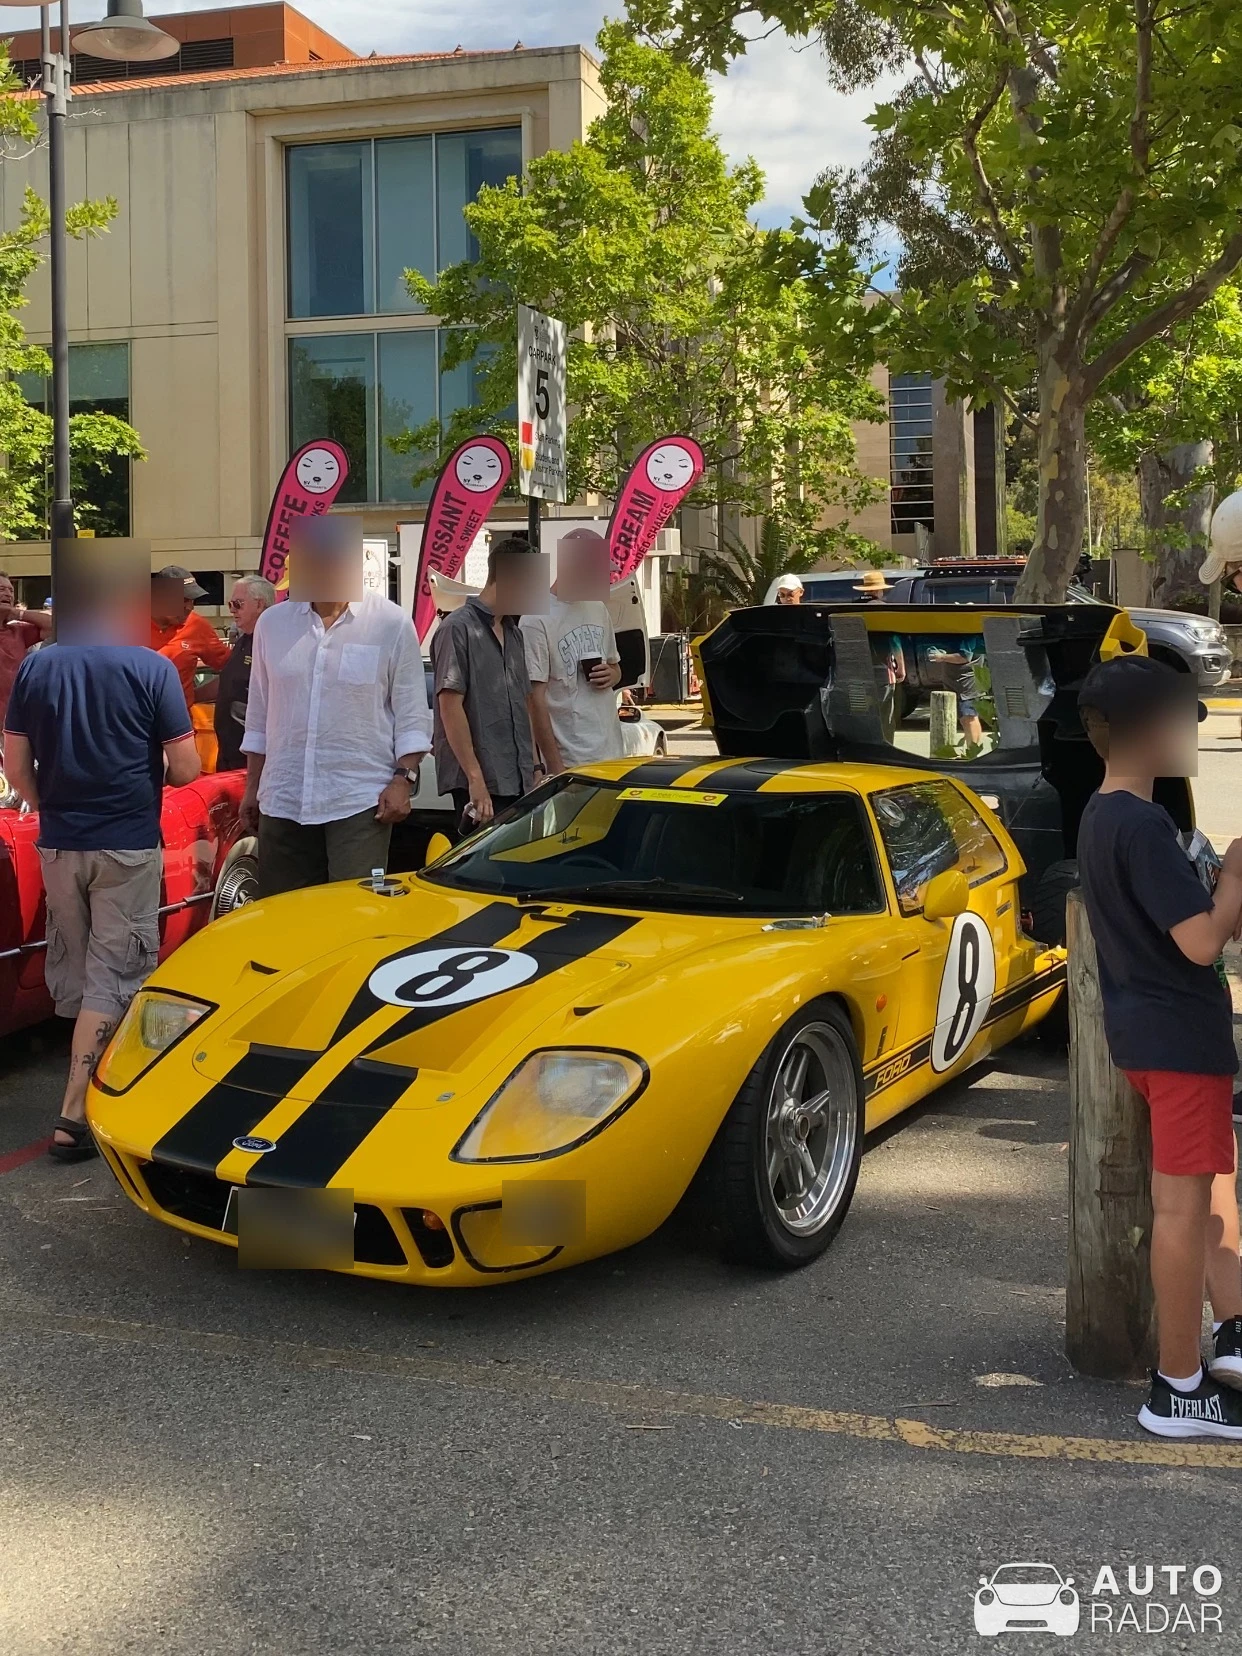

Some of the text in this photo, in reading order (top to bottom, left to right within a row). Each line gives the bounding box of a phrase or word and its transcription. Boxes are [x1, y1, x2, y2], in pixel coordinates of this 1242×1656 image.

[528, 345, 557, 366] CARPARK
[535, 368, 550, 420] 5
[545, 434, 561, 449] Parking
[548, 465, 564, 480] Parking
[460, 509, 483, 542] SWEET
[611, 488, 657, 570] CREAM
[629, 540, 651, 571] OADED
[648, 502, 674, 540] SHAKES
[421, 490, 467, 597] COISSANT
[458, 542, 468, 553] &
[445, 553, 461, 580] OURY
[394, 950, 511, 1003] 8
[943, 921, 980, 1062] 8
[874, 1053, 912, 1090] FORD
[241, 1139, 267, 1149] Ford
[1169, 1393, 1224, 1423] EVERLAST
